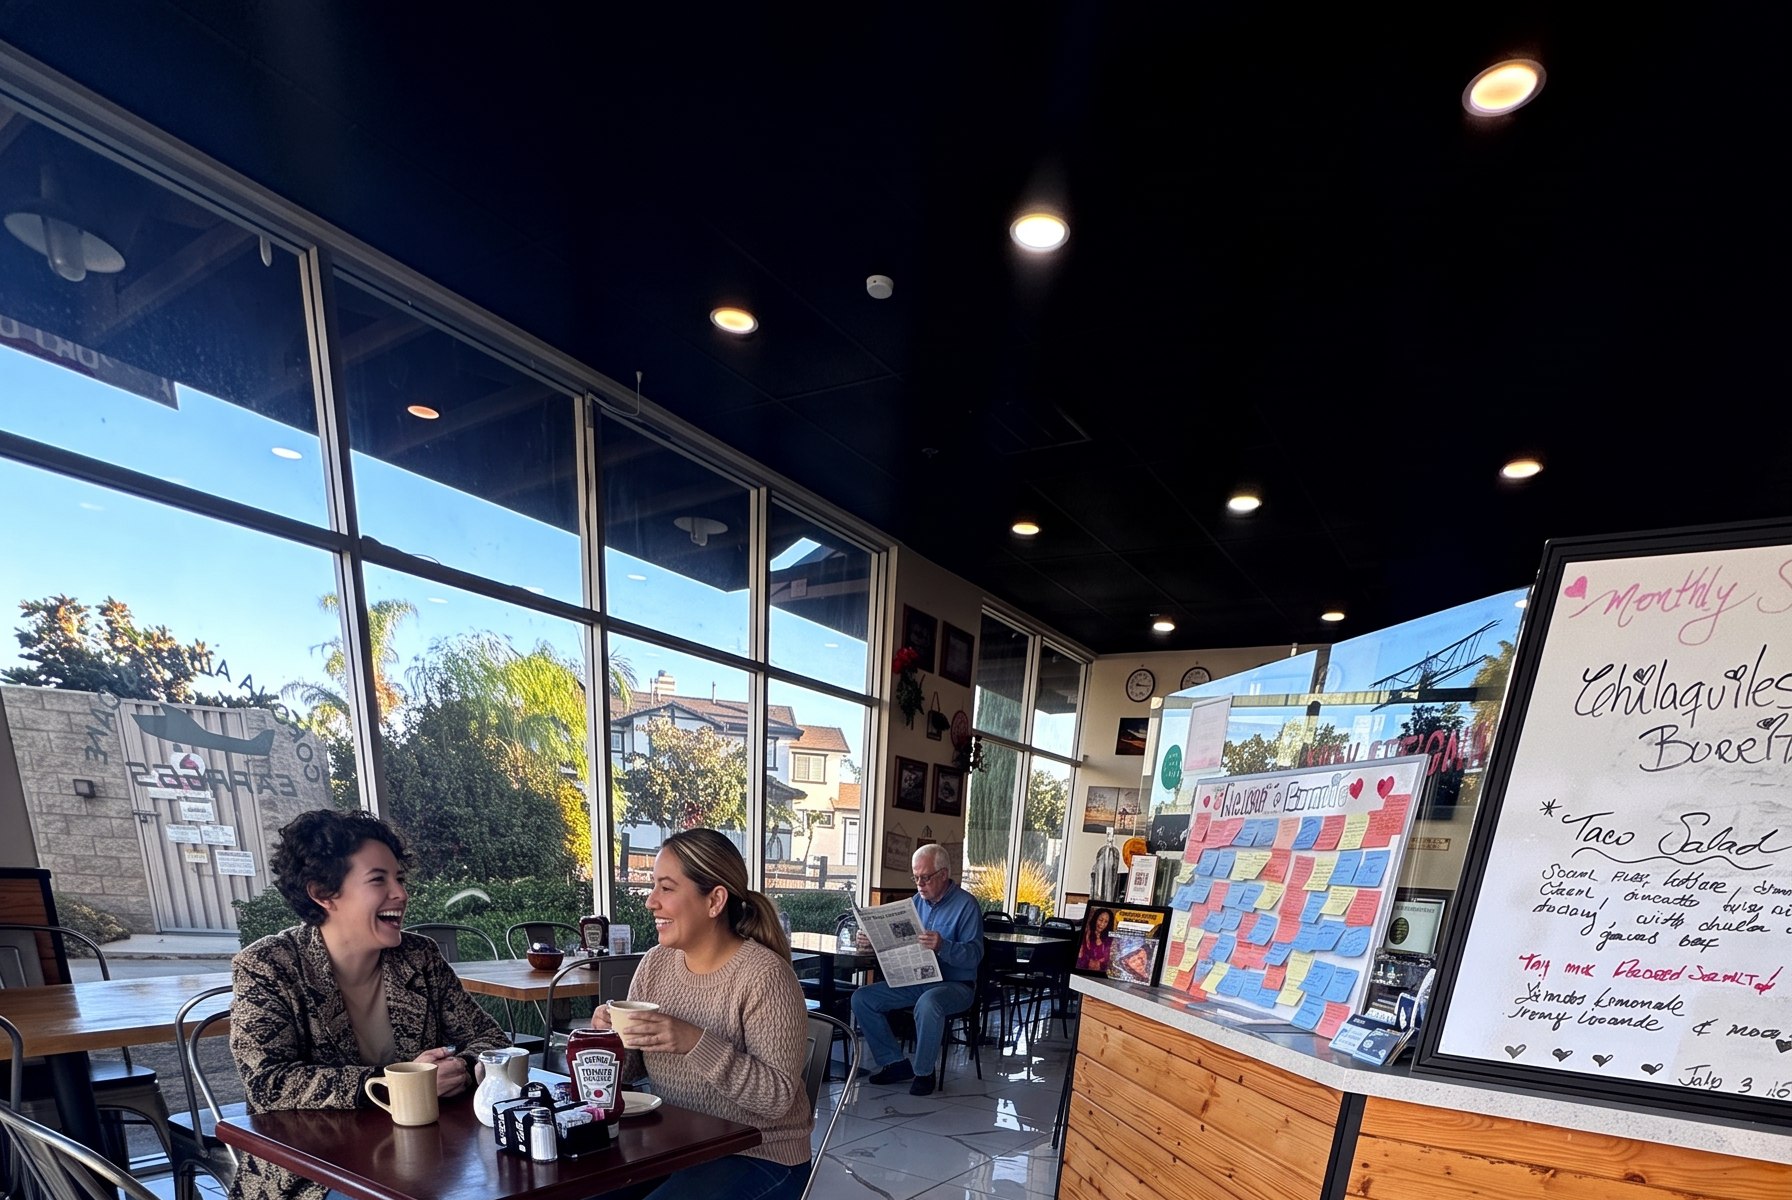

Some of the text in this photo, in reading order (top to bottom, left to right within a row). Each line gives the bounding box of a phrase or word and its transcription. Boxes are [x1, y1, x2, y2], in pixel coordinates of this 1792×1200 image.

[1569, 565, 1756, 646] Monthly
[1574, 643, 1792, 729] Chilaquiles
[1562, 811, 1792, 855] Taco Salad
[1737, 1077, 1754, 1094] 3
